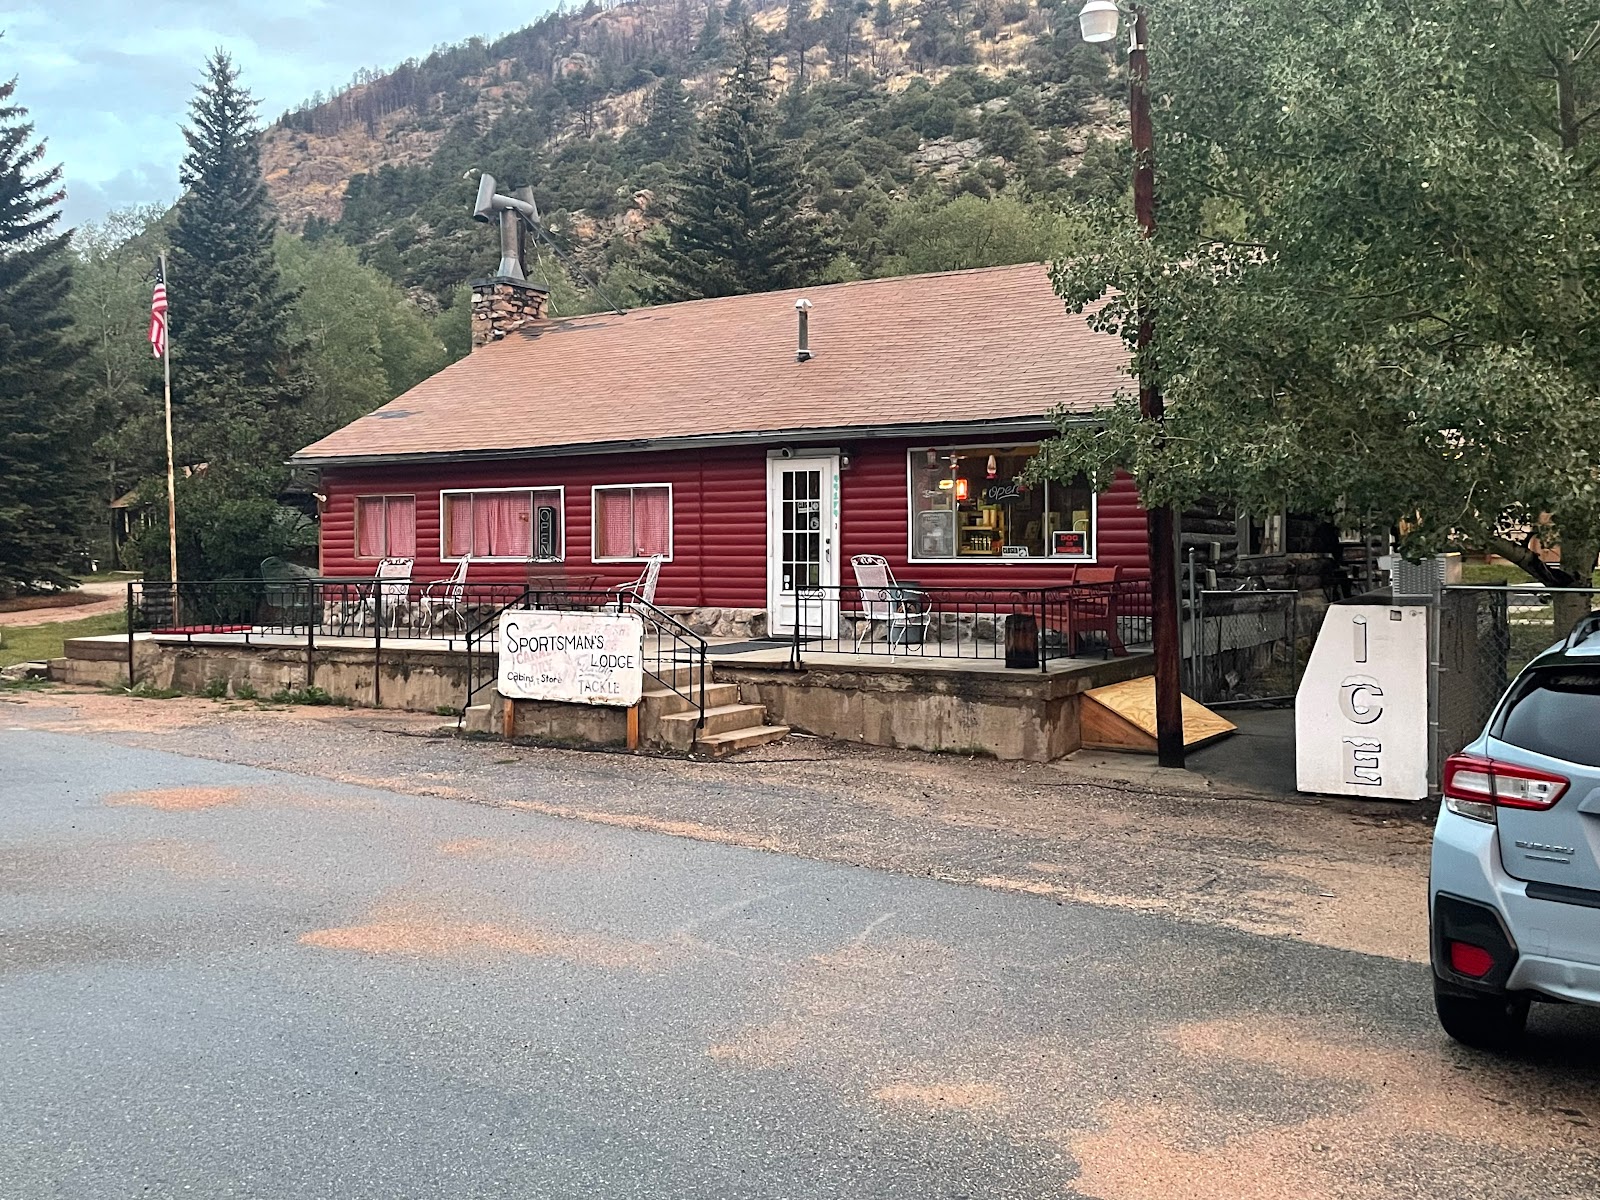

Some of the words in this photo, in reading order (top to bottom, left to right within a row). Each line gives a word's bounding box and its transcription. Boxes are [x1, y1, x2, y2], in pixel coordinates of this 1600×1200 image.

[540, 509, 550, 554] OPEN
[506, 622, 605, 654] SPORTSMAN'S
[590, 653, 634, 669] LODGE
[507, 671, 534, 683] Cabins
[541, 673, 563, 684] Store
[578, 679, 620, 695] TACKLE
[1338, 613, 1384, 787] ICE
[1515, 840, 1575, 855] SUBARU
